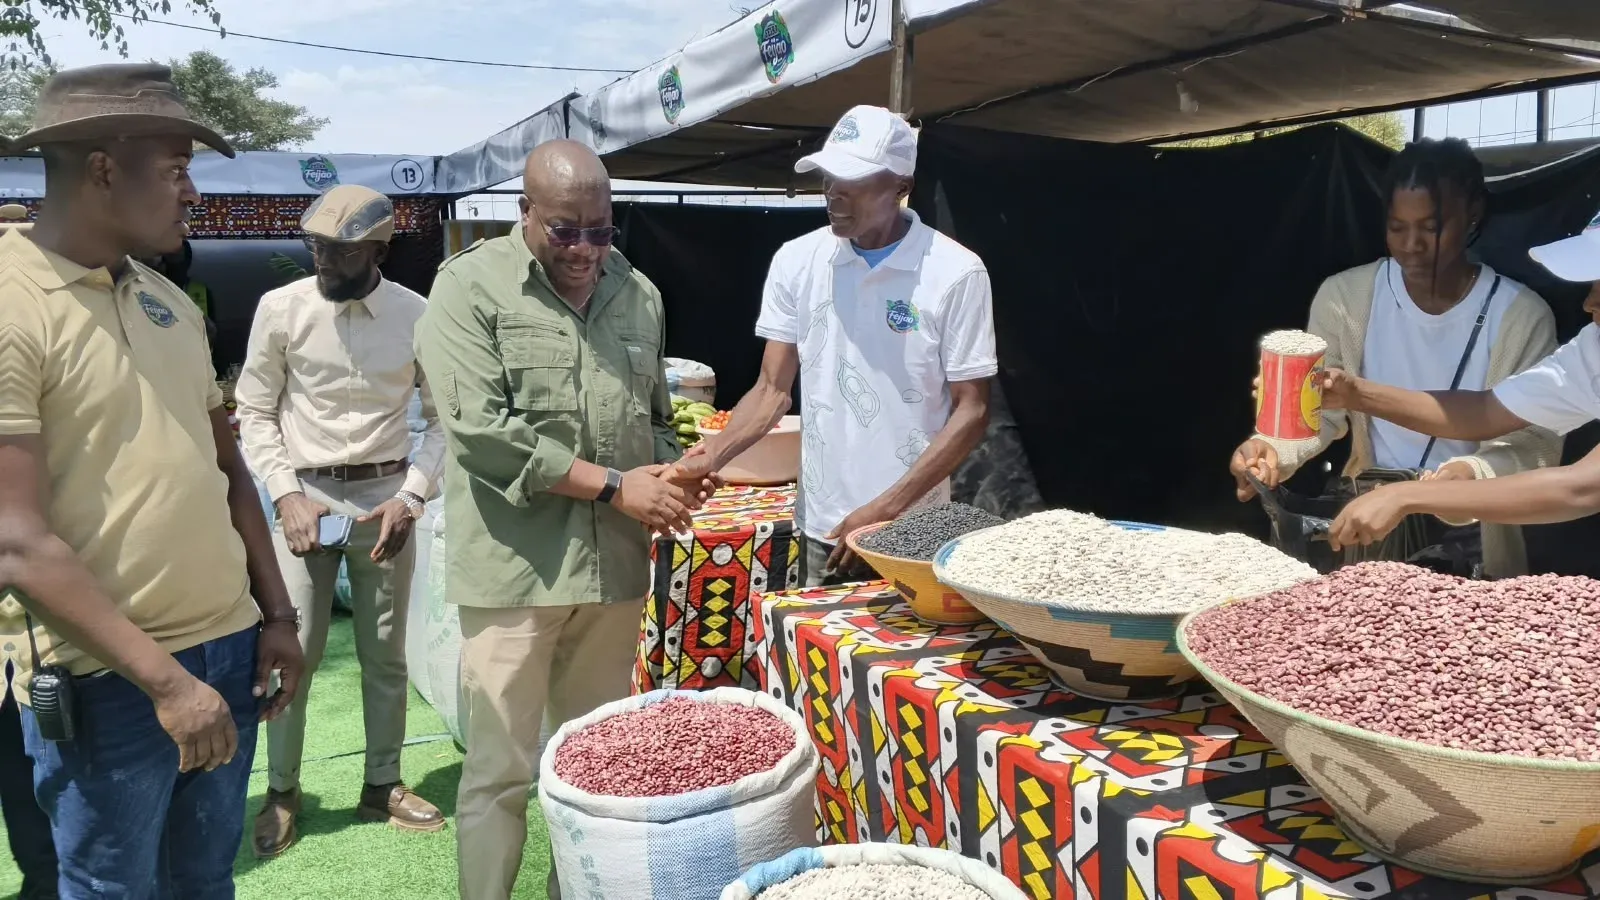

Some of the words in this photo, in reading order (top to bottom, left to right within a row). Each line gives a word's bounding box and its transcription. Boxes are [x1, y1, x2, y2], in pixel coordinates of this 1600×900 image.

[760, 38, 787, 66] Feijão
[304, 169, 332, 182] Feijão
[402, 167, 416, 184] 13
